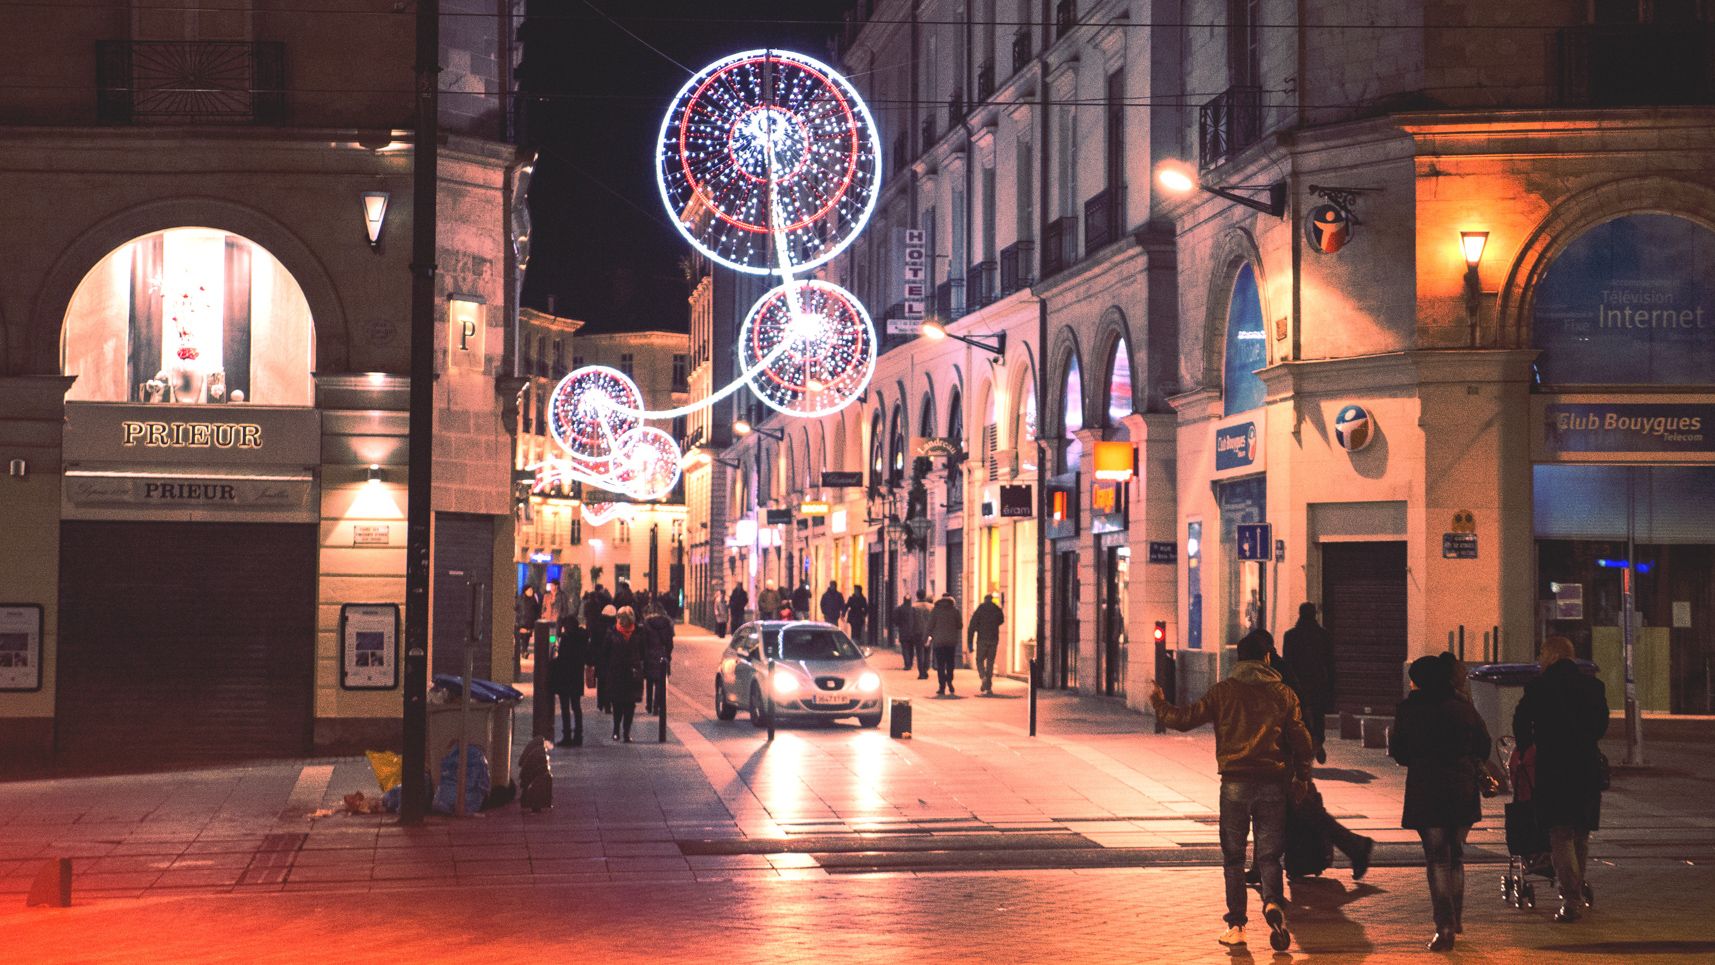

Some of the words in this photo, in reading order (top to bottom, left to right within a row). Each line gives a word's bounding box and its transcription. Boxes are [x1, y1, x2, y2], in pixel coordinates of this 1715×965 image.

[907, 231, 924, 314] HOTEL
[1601, 289, 1673, 304] Télévision
[1600, 304, 1705, 328] Internet
[460, 320, 476, 350] P
[122, 421, 263, 448] PRIEUR
[1557, 412, 1600, 430] Club
[1604, 413, 1701, 435] Bouygues
[1663, 432, 1704, 442] Telecom
[144, 482, 236, 500] PRIEUR
[1003, 504, 1031, 516] éram
